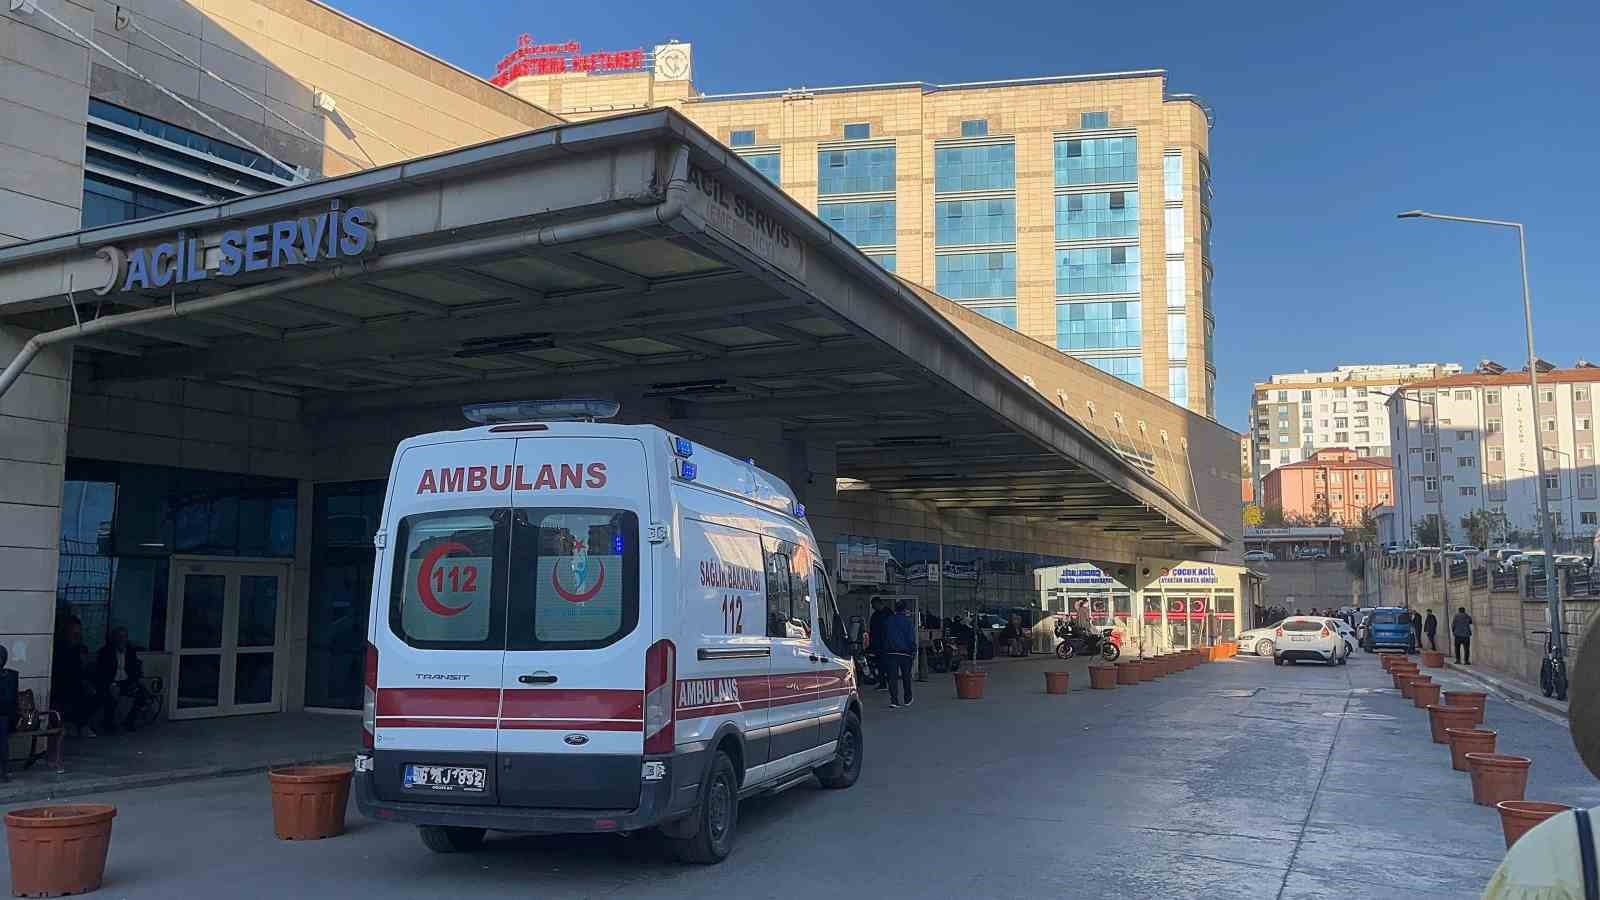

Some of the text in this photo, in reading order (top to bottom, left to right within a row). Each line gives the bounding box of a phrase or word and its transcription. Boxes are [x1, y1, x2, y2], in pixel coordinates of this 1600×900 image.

[120, 199, 373, 291] ACİL SERVİS
[416, 462, 608, 495] AMBULANS
[432, 566, 479, 593] 112
[722, 594, 743, 634] 112
[415, 673, 471, 682] TRANSIT
[678, 678, 739, 708] AMBULANS
